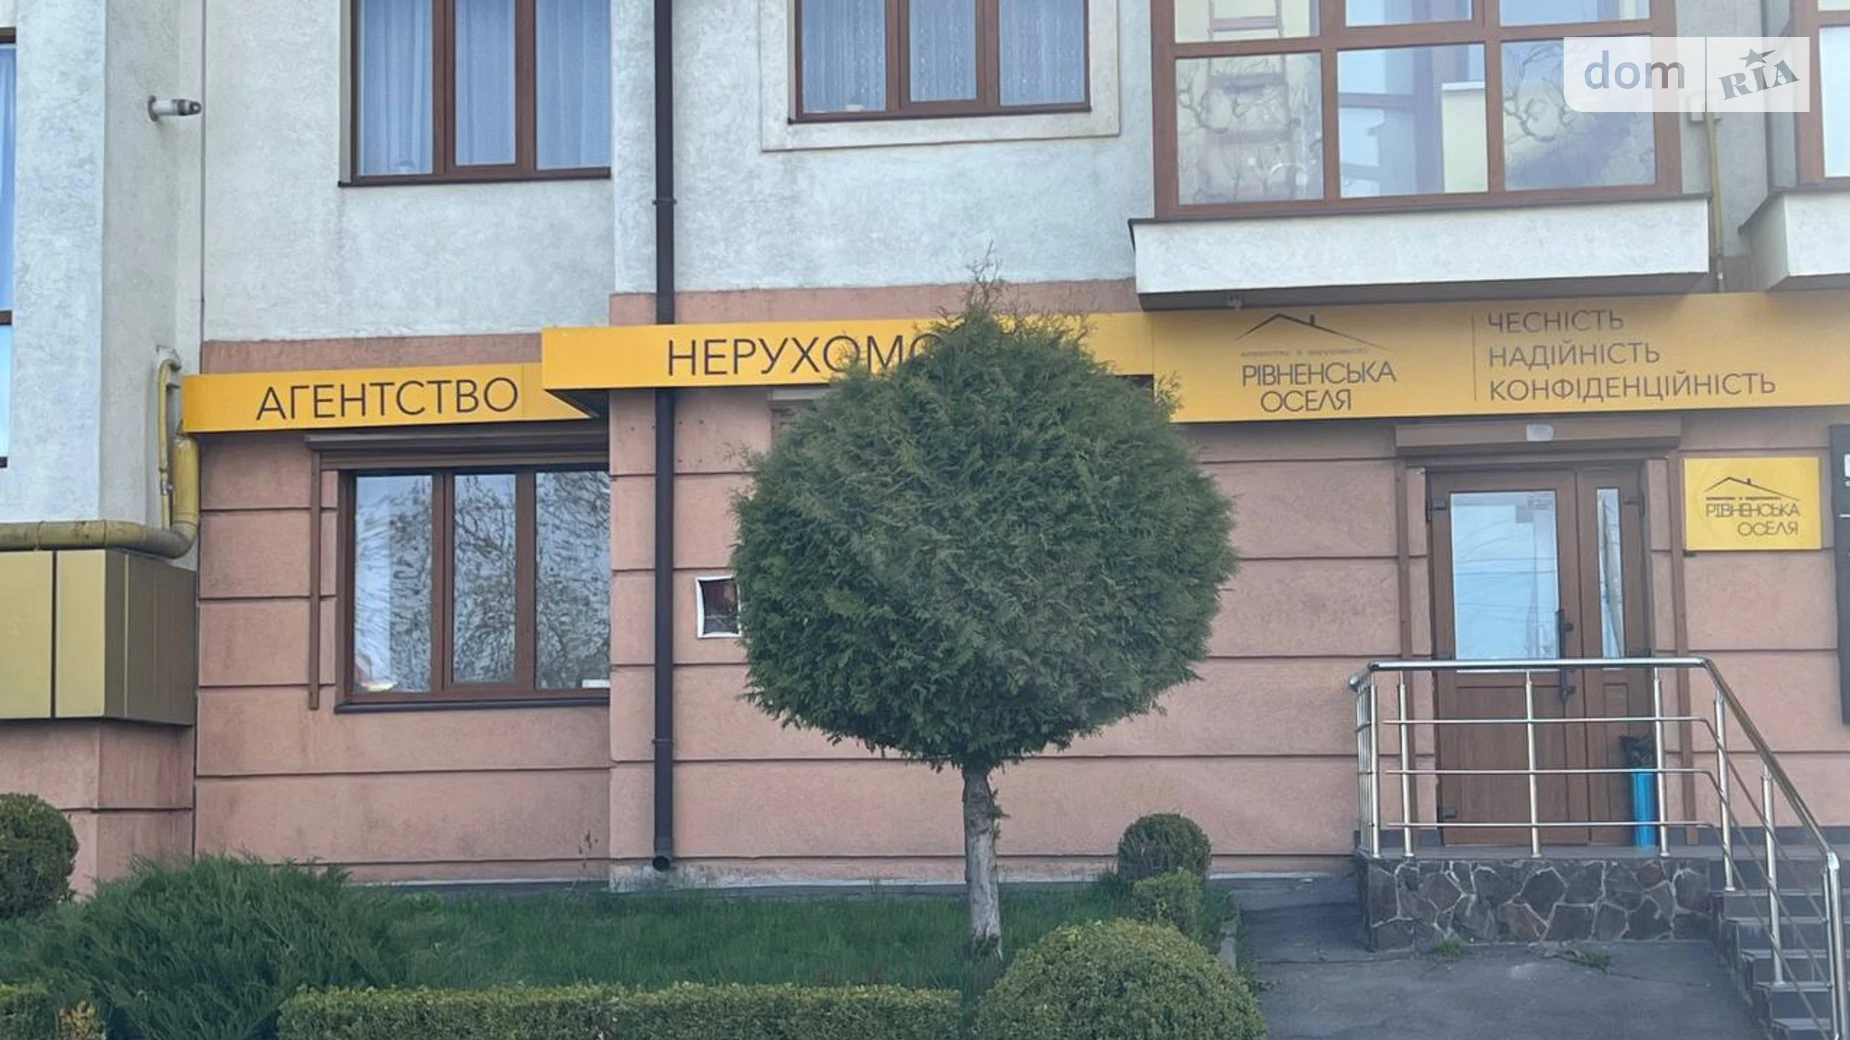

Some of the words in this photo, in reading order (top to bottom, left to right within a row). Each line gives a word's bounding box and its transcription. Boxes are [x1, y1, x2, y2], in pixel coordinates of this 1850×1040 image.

[1488, 310, 1625, 333] ЧЕСНІСТЬ
[1489, 340, 1661, 370] НАДІЙНІСТЬ
[1242, 361, 1397, 386] РІВНЕНСЬКА
[256, 376, 519, 421] АГЕНТСТВО
[1490, 370, 1777, 403] КОНФІДЕНЦІЙНІСТЬ
[1260, 389, 1352, 413] ОСЕЛЯ
[1705, 502, 1801, 518] РІВНЕНСЬКА
[1737, 521, 1799, 537] ОСЕЛЯ
